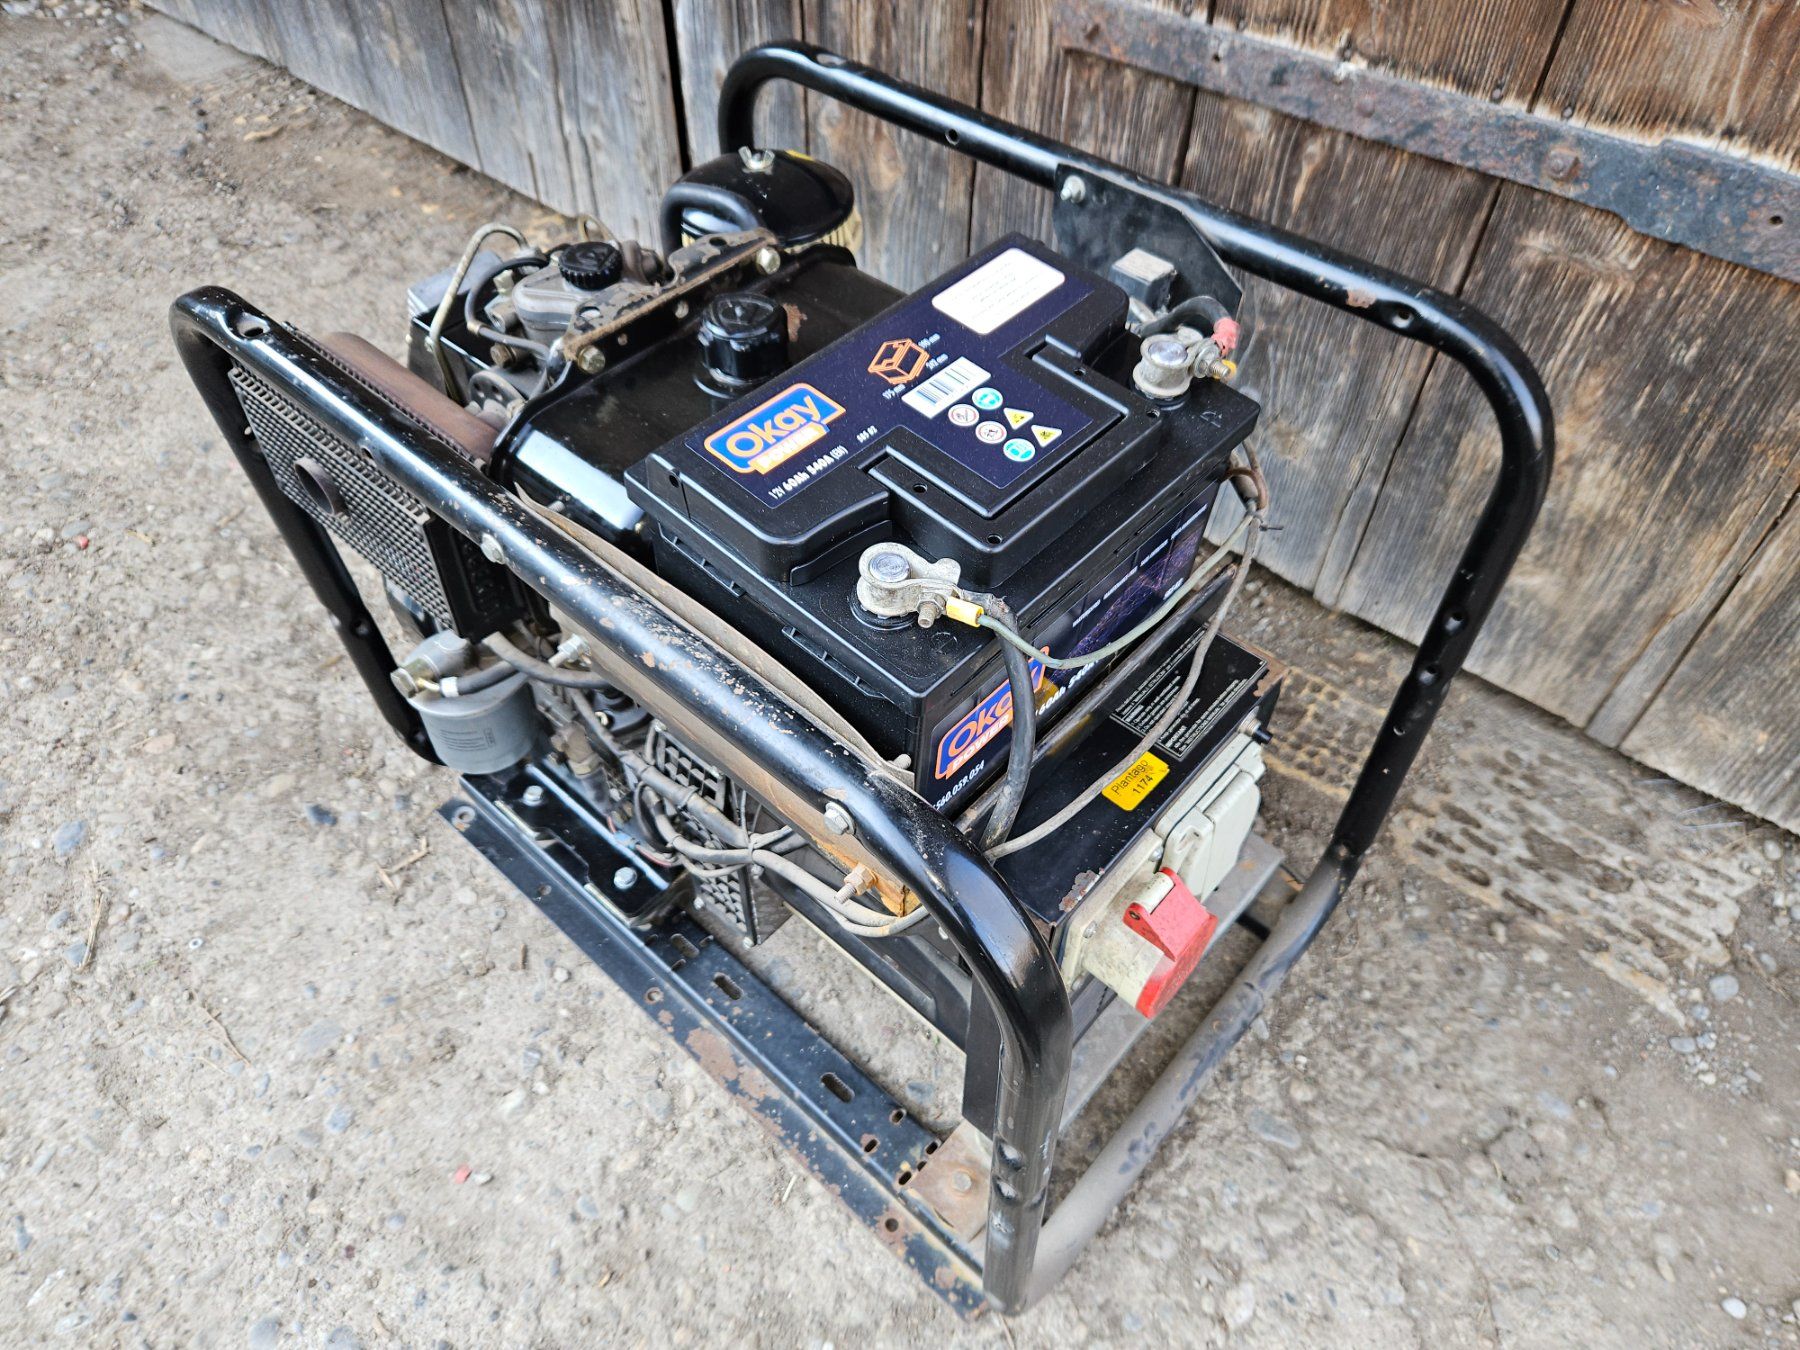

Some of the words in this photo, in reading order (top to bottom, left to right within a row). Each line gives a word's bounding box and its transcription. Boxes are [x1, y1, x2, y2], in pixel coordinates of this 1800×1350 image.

[726, 395, 821, 458] Okay
[768, 487, 786, 500] 12V
[782, 469, 810, 492] 60Ah
[806, 455, 836, 476] 540A
[952, 715, 1011, 773] POWER
[1110, 760, 1148, 795] Plantago
[1133, 775, 1153, 794] 1174
